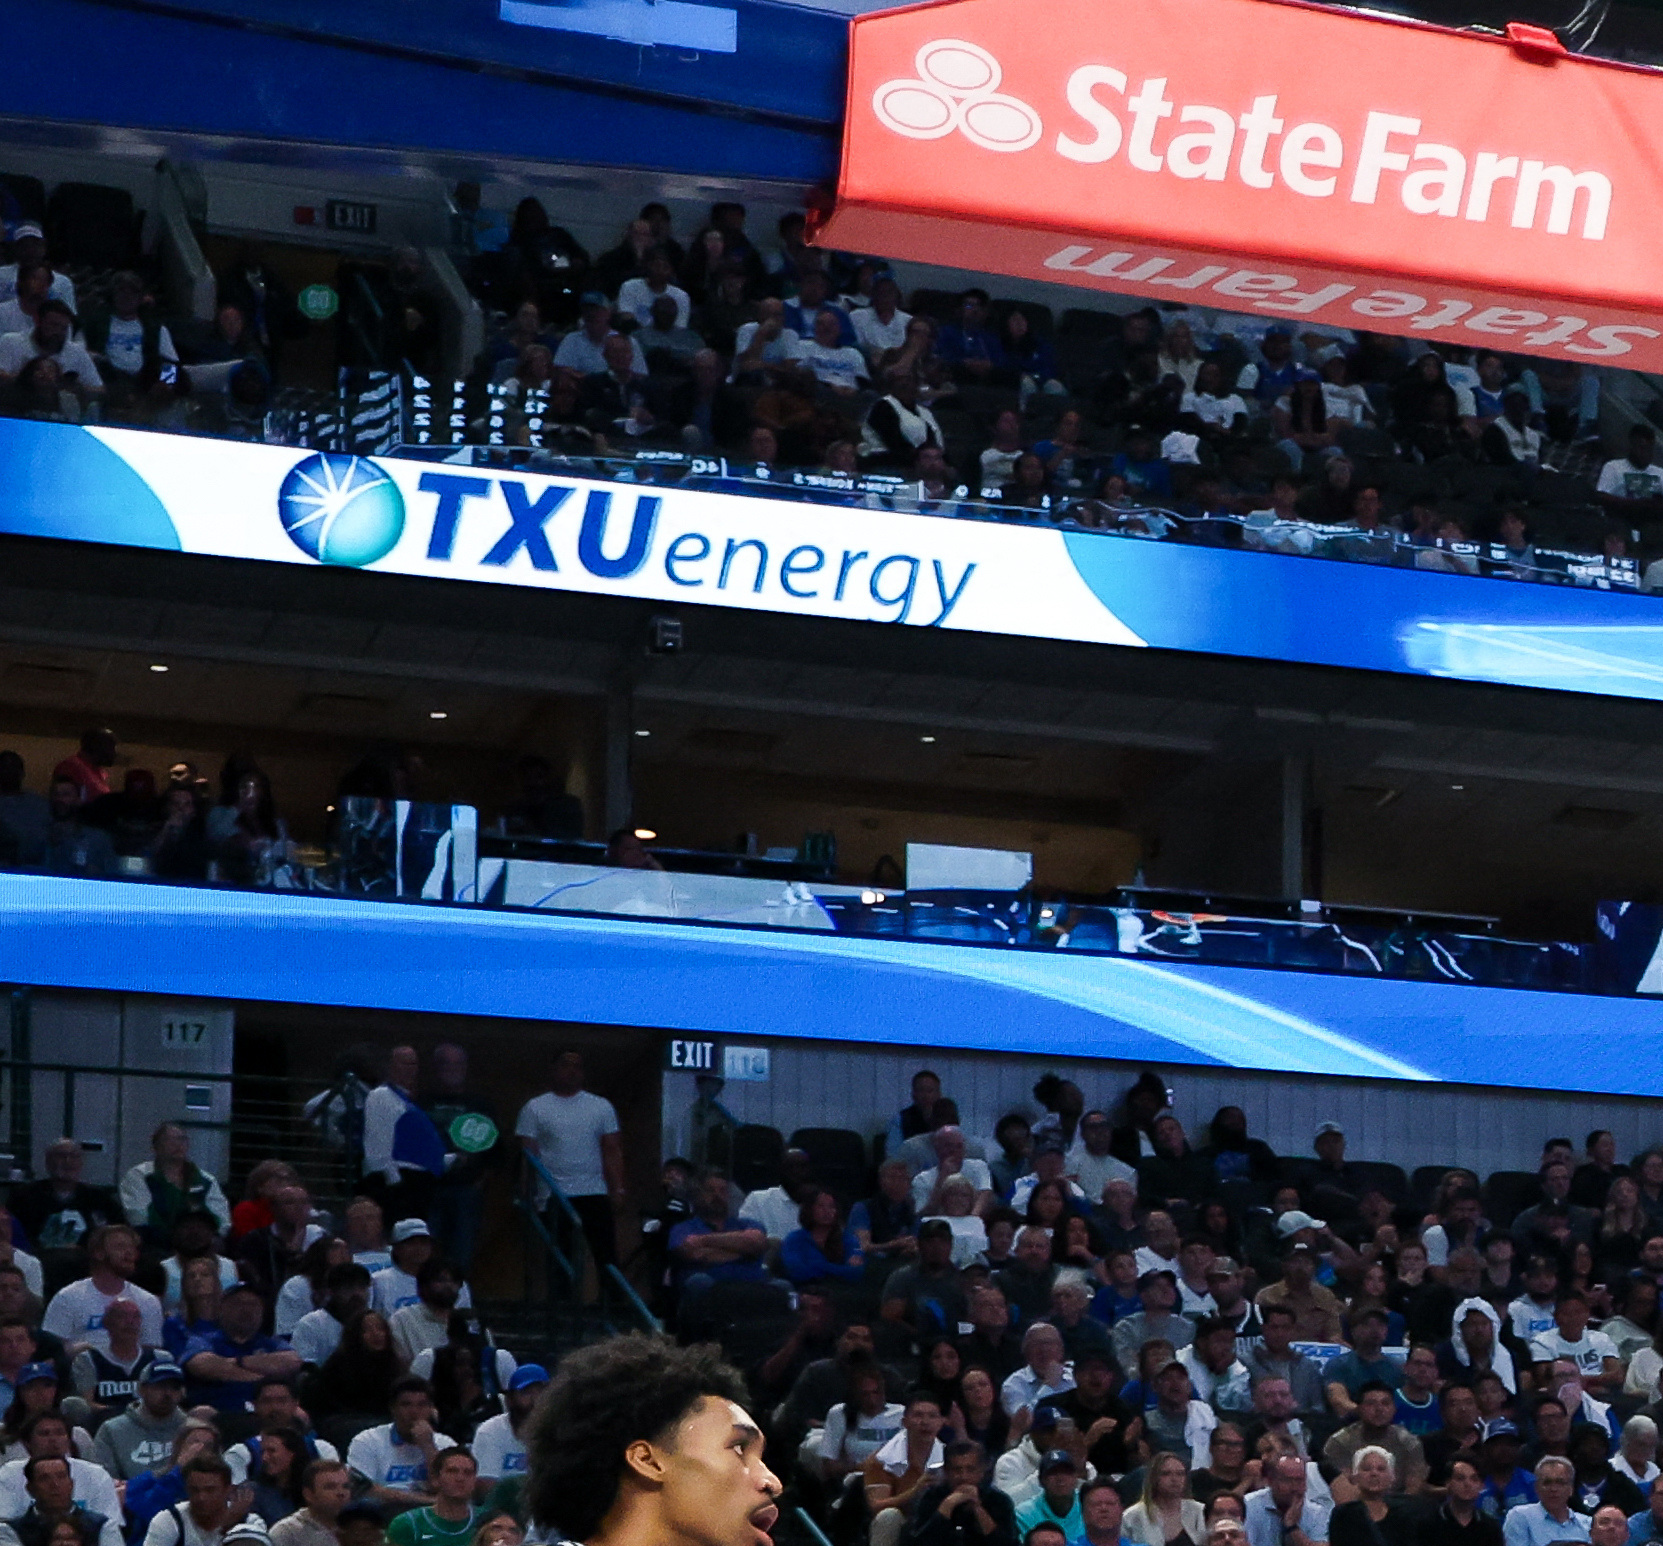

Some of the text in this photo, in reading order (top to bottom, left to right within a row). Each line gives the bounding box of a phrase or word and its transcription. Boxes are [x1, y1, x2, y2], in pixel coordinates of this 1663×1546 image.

[418, 472, 662, 579] TXU
[663, 535, 978, 627] energy
[165, 1022, 205, 1043] 117
[671, 1039, 714, 1068] EXIT
